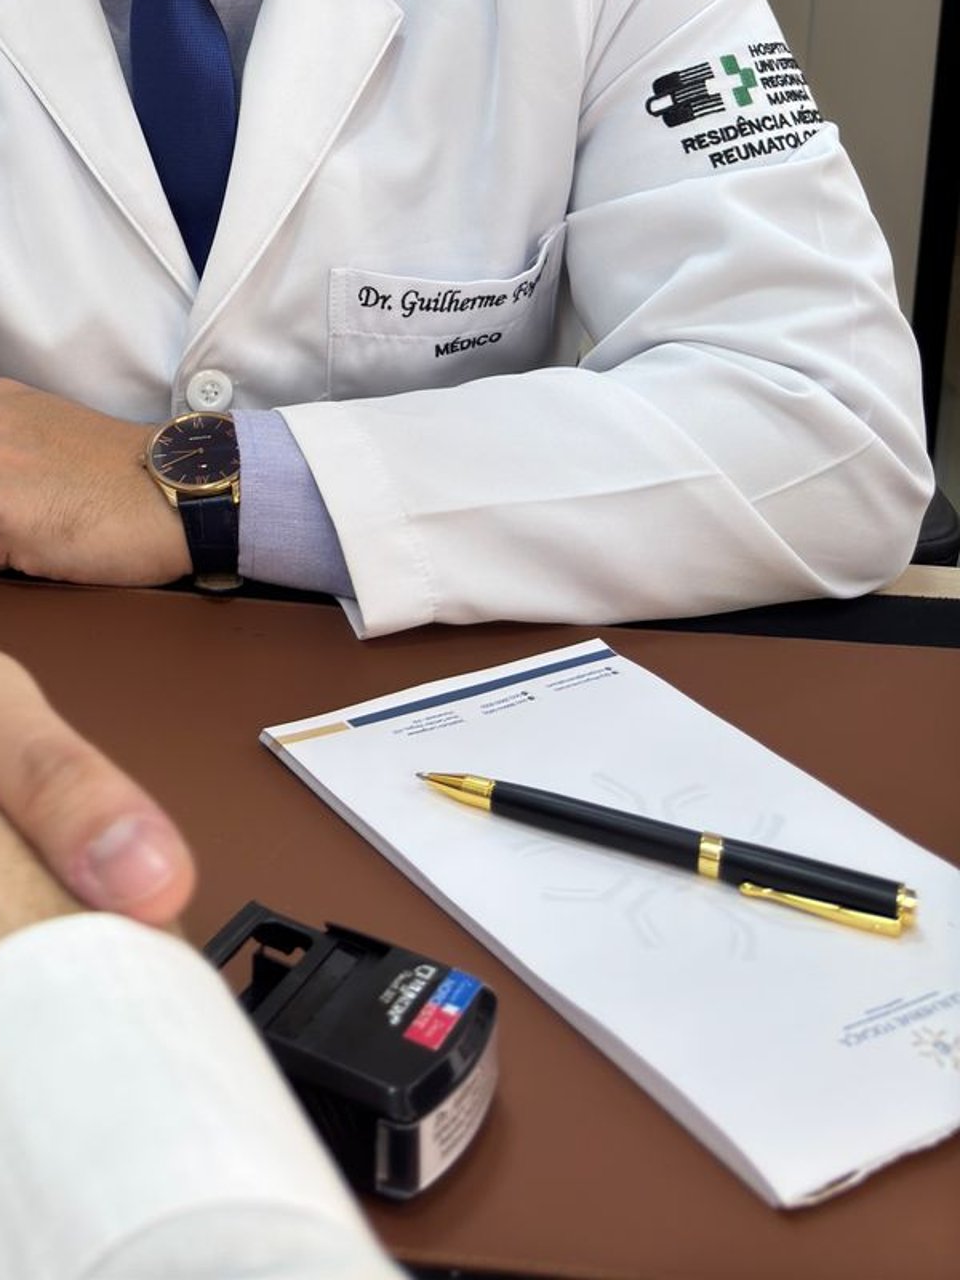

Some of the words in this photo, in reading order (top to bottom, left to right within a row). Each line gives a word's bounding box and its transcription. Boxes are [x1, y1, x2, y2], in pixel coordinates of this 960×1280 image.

[681, 114, 792, 155] RESIDÊNCIA
[358, 285, 393, 309] Dr.
[401, 289, 508, 318] Guilherme
[434, 332, 503, 359] MÉDICO
